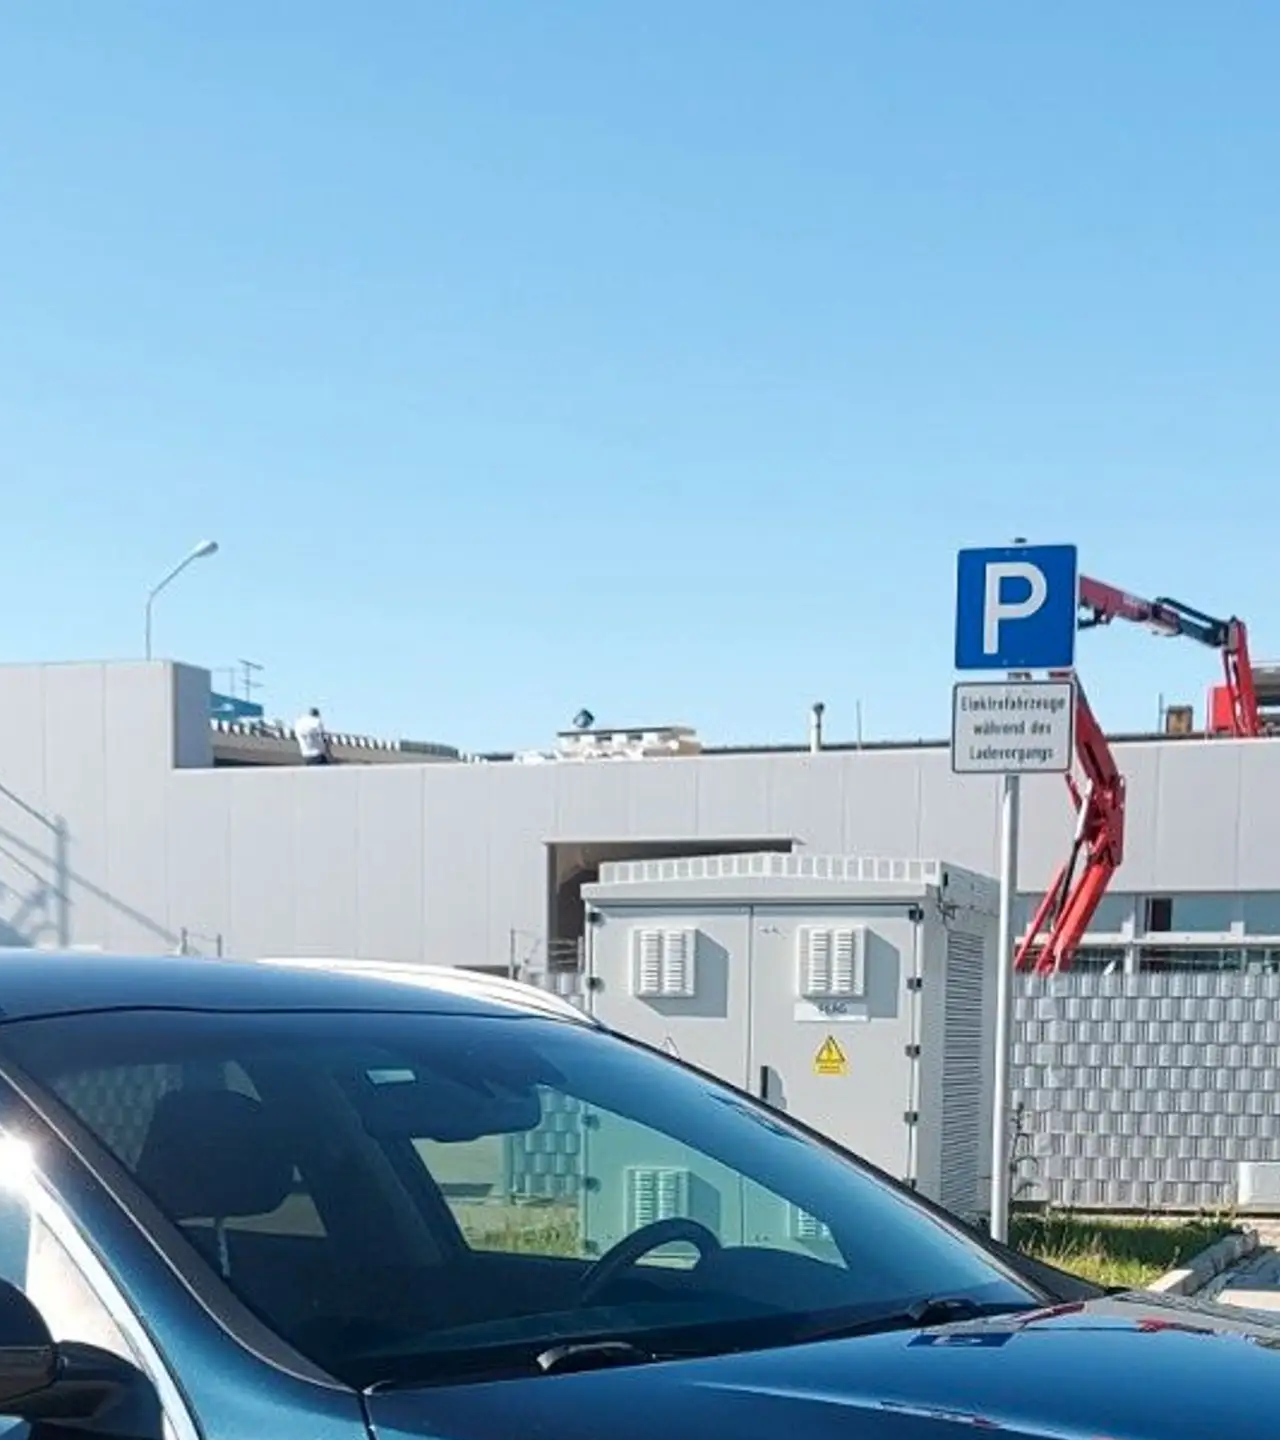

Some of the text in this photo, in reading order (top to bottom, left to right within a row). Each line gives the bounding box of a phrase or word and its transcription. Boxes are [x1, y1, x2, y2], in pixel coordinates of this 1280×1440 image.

[983, 562, 1047, 654] P
[960, 695, 1066, 714] Elektrofahrzeuge
[973, 720, 1052, 735] während des
[969, 745, 1055, 762] Ladevorgangs
